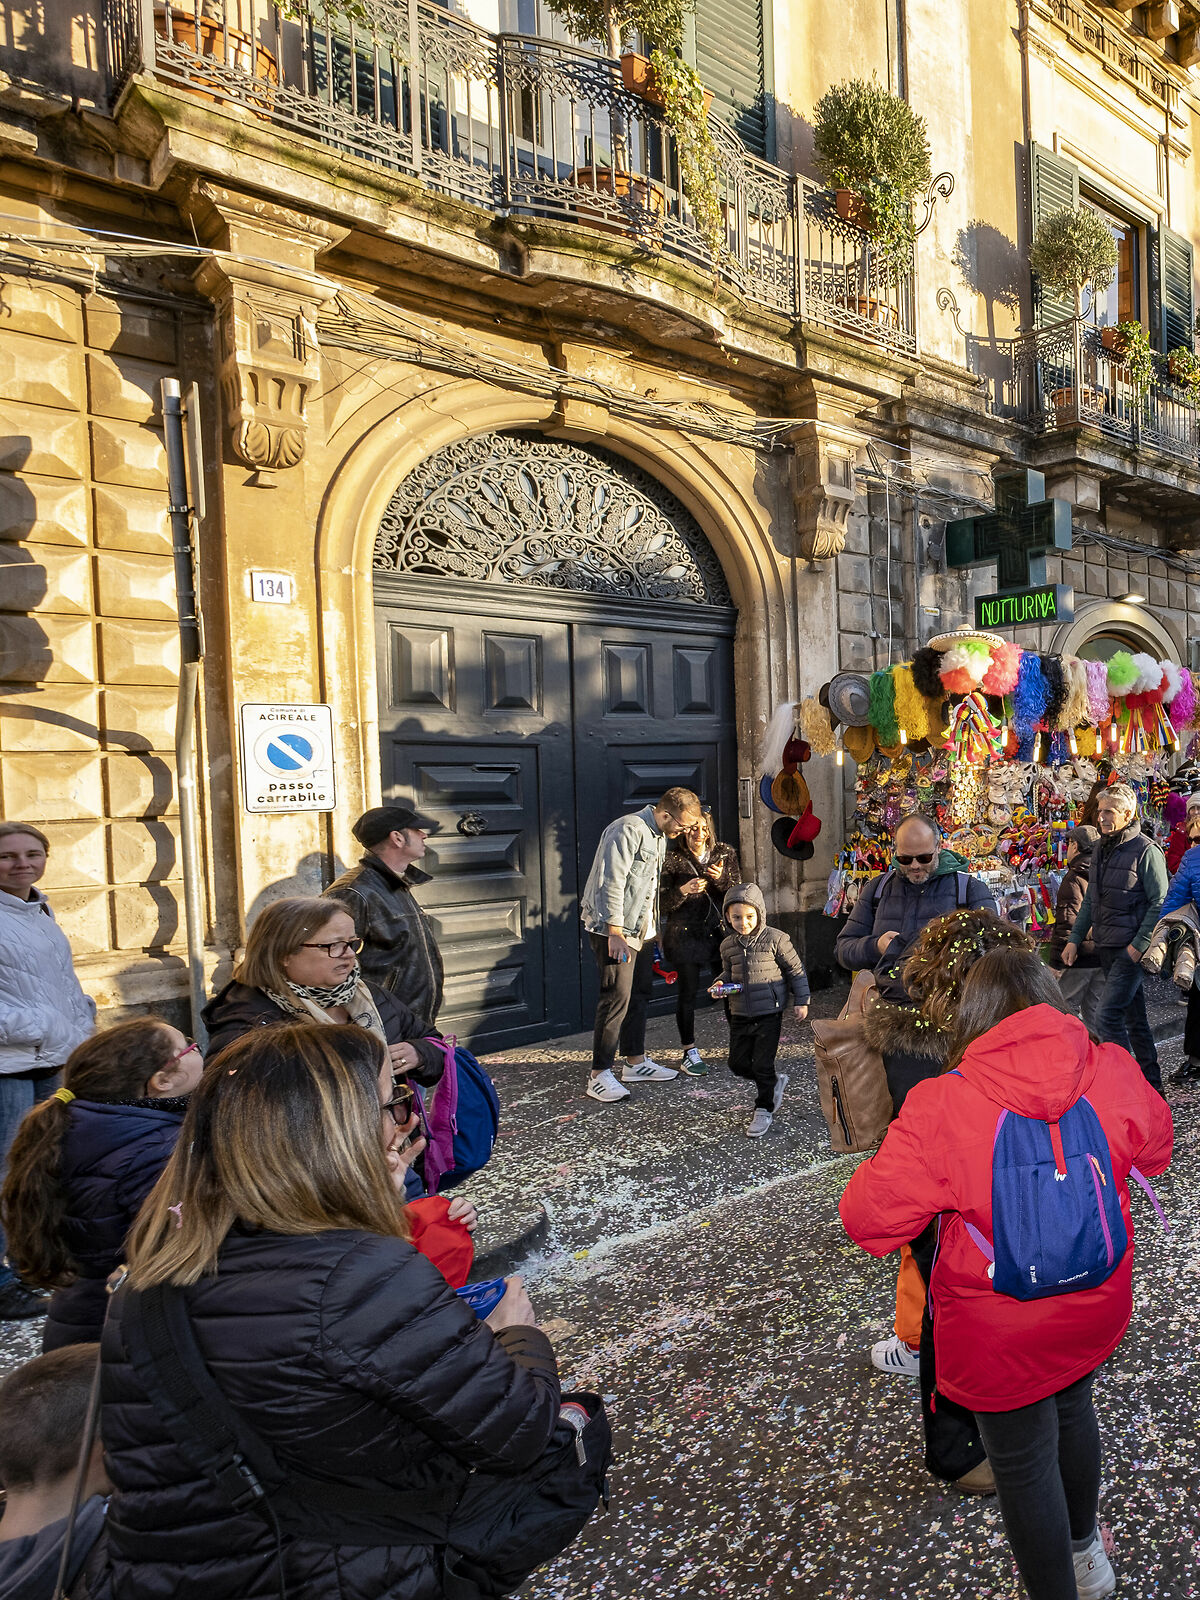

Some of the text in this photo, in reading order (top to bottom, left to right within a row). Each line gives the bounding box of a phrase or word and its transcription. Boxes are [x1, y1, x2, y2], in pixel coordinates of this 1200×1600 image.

[259, 579, 284, 598] 134
[982, 592, 1056, 626] NOTTURNA
[259, 713, 317, 722] ACIREALE
[269, 782, 314, 793] passo
[257, 792, 326, 803] carrabile
